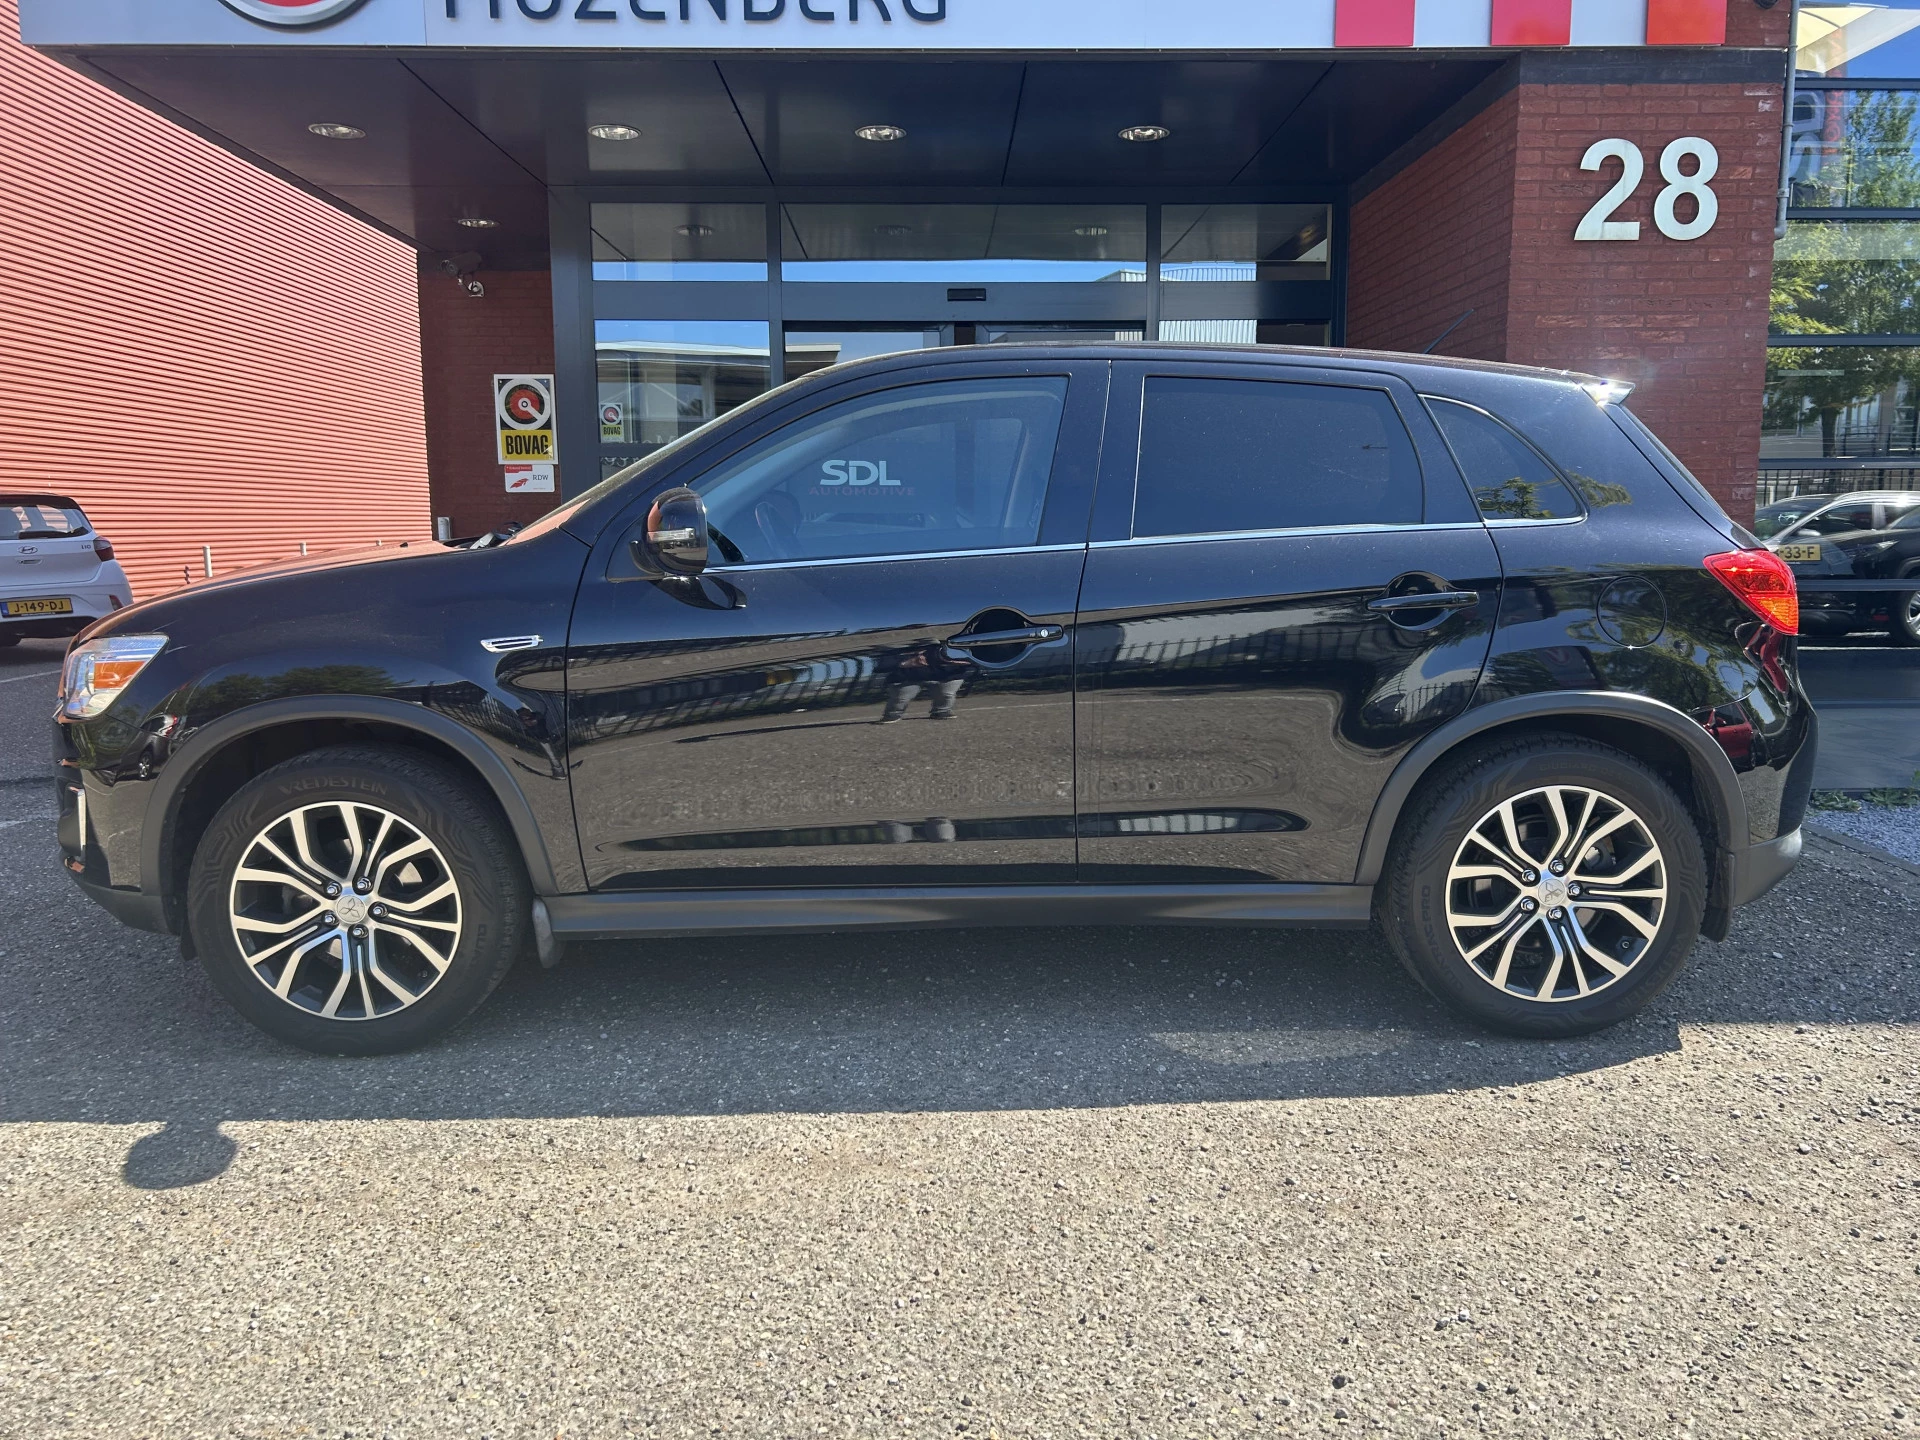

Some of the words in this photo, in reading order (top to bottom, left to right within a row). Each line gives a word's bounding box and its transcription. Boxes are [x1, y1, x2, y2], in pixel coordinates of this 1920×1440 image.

[1574, 137, 1719, 241] 28
[603, 426, 621, 435] BOVAG
[506, 434, 549, 454] BOVAG
[820, 460, 901, 485] SDL
[809, 486, 915, 496] AUTOMOTIVE
[14, 600, 64, 613] J-149-DJ
[279, 775, 389, 796] VREDESTEIN
